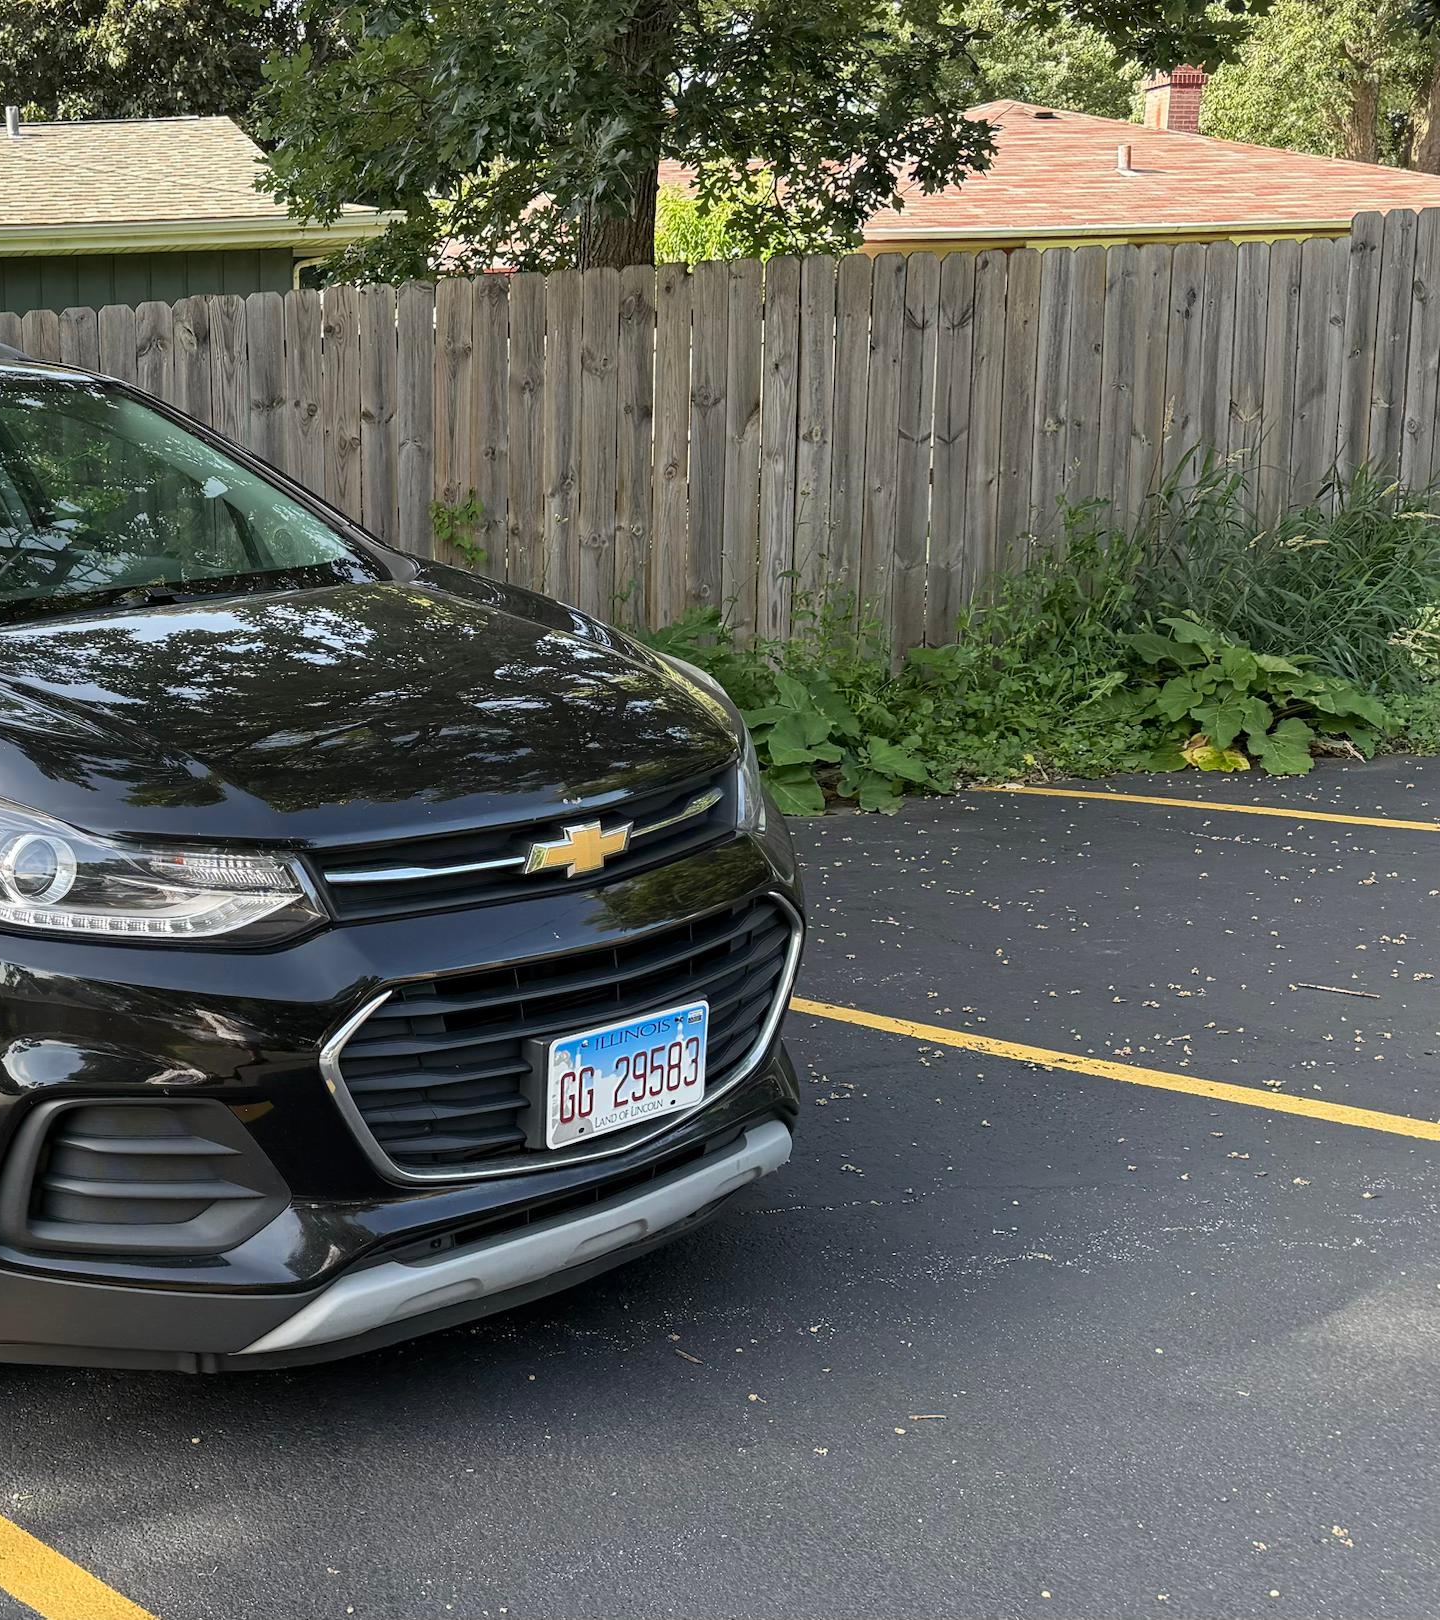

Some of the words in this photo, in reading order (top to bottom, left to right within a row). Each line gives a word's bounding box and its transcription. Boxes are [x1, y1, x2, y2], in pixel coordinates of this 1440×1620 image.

[595, 1018, 671, 1051] ILLINOIS
[560, 1066, 594, 1124] GG
[614, 1036, 700, 1108] 29583
[595, 1112, 617, 1128] LAND
[619, 1109, 629, 1121] OF
[630, 1098, 664, 1117] LINCOLN
